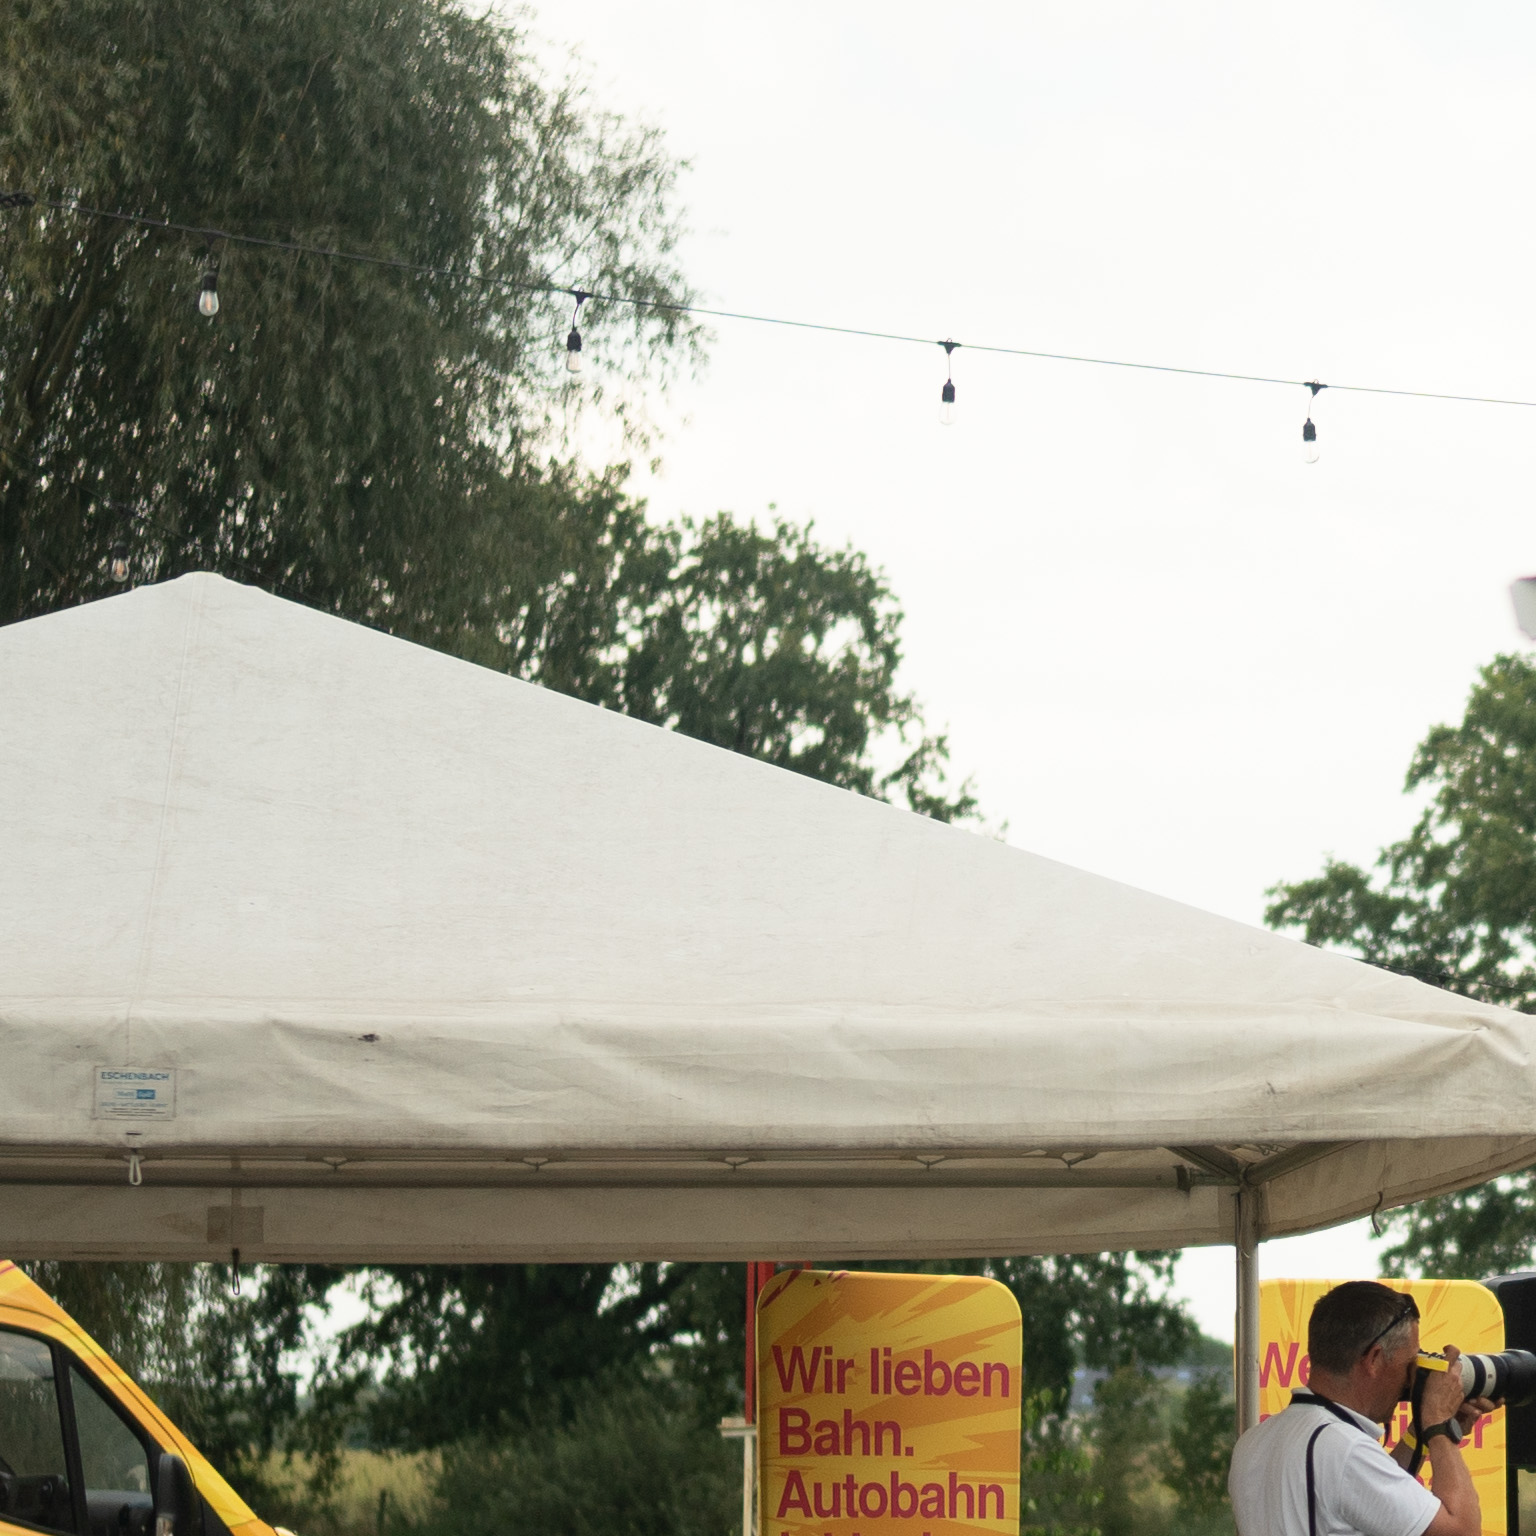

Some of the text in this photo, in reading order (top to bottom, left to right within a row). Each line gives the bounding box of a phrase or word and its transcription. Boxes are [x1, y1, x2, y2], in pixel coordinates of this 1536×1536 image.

[771, 1345, 1010, 1397] Wir lieben
[778, 1408, 914, 1456] Bahn.
[776, 1470, 1005, 1520] Autobahn
